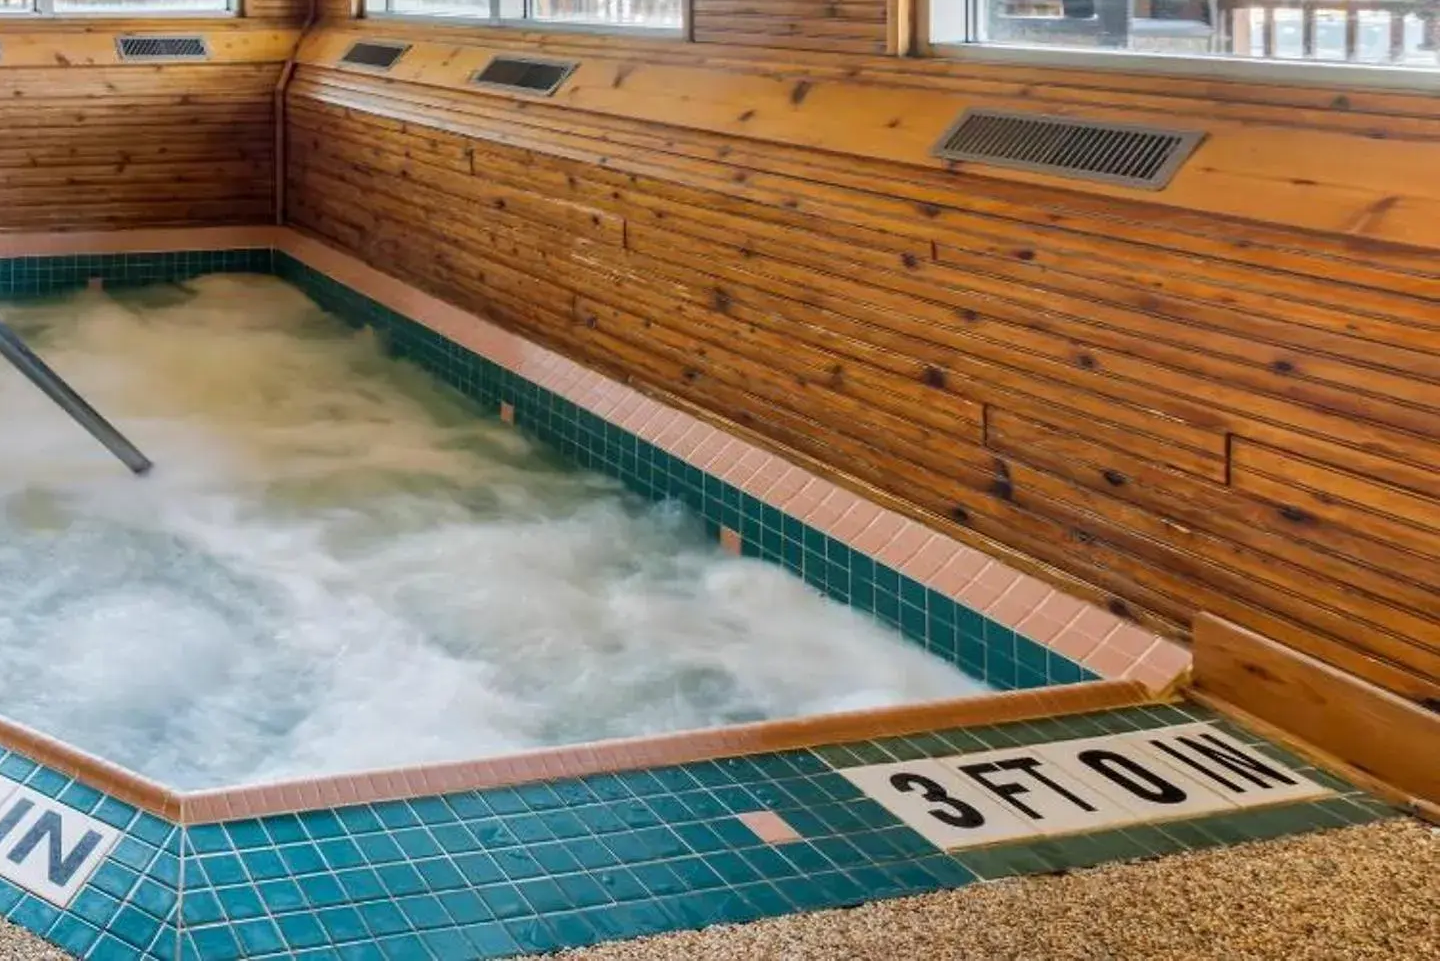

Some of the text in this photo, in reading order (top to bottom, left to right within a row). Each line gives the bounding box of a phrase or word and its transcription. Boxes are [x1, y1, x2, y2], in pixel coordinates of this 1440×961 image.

[890, 772, 986, 828] 3
[957, 757, 1098, 820] FT
[1149, 733, 1300, 794] IN
